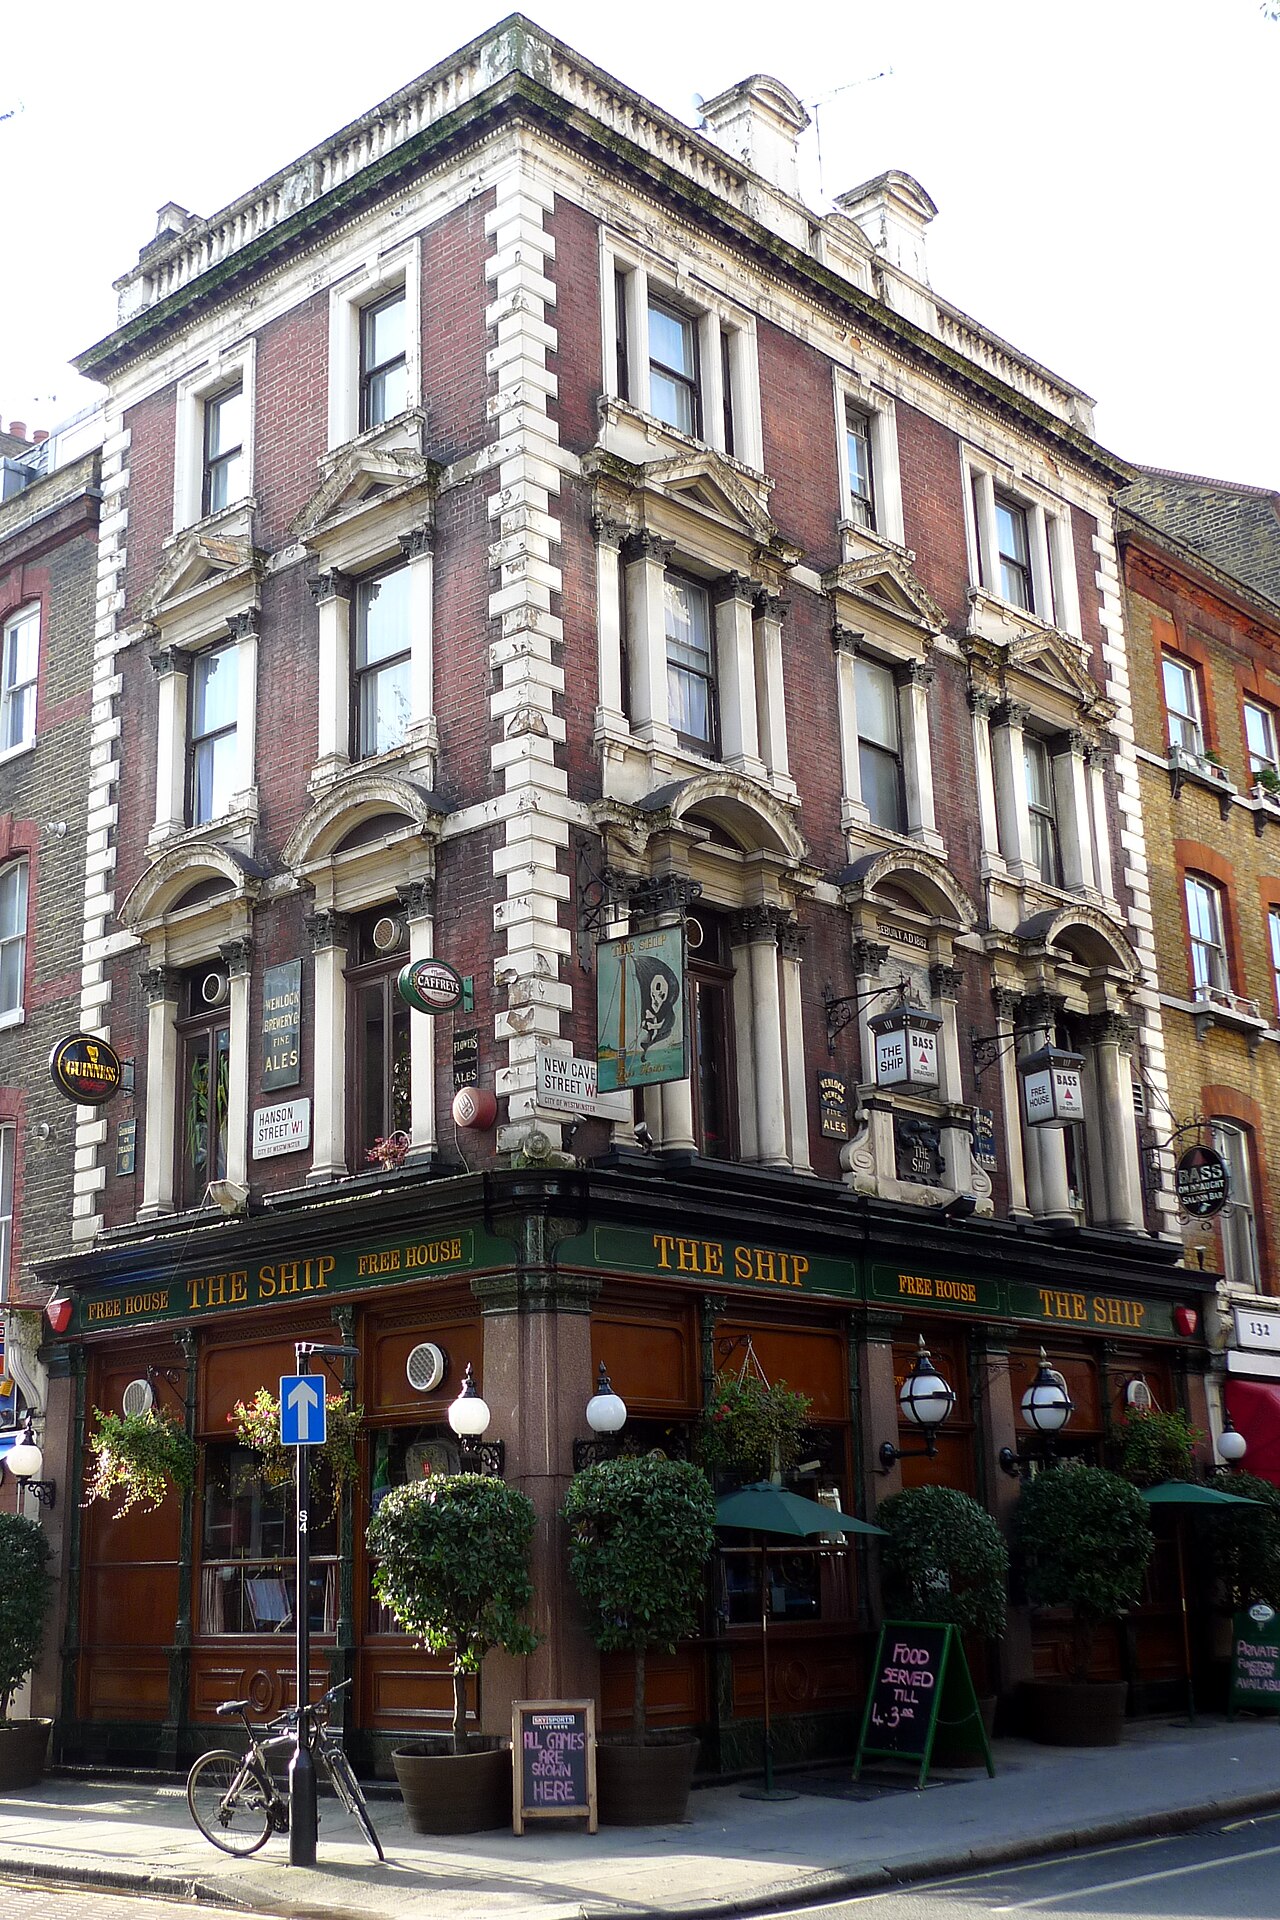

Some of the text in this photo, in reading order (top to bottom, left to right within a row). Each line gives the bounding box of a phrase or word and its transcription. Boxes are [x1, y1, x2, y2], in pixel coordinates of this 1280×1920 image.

[638, 934, 666, 951] SHIP
[264, 1013, 294, 1033] BREWERY
[273, 1034, 290, 1047] FINE
[912, 1035, 934, 1050] BASS
[881, 1044, 902, 1059] THE
[265, 1050, 298, 1073] ALES
[544, 1057, 567, 1075] NEW
[880, 1057, 904, 1072] SHIP
[65, 1061, 116, 1082] GUINNESS
[454, 1069, 477, 1084] ALES
[913, 1068, 935, 1078] DRAUGHT
[544, 1075, 582, 1094] STREET
[820, 1078, 846, 1094] WENLOCK
[1056, 1074, 1077, 1087] BASS
[822, 1090, 845, 1104] BREWERY
[1030, 1085, 1047, 1097] FREE
[544, 1097, 555, 1105] CITY
[563, 1100, 596, 1113] WESTMINSTER
[1029, 1094, 1050, 1108] HOUSE
[258, 1106, 293, 1127] HANSON
[258, 1119, 303, 1142] STREET W1
[823, 1119, 846, 1133] ALES
[257, 1148, 266, 1156] CITY
[273, 1140, 301, 1152] WESTMINSTER
[914, 1145, 929, 1160] THE
[912, 1158, 931, 1174] SHIP
[1178, 1164, 1223, 1185] BASS
[1178, 1180, 1224, 1194] ON DRAUGHT
[1182, 1191, 1223, 1205] SALOON BAR
[357, 1238, 461, 1276] FREE HOUSE
[653, 1234, 809, 1286] THE SHIP
[186, 1255, 336, 1310] THE SHIP
[898, 1274, 977, 1302] FREE HOUSE
[88, 1298, 121, 1321] FREE
[124, 1290, 169, 1315] HOUSE
[1039, 1289, 1145, 1328] THE SHIP
[1249, 1321, 1270, 1337] 132
[892, 1643, 930, 1665] FOOD
[1237, 1640, 1279, 1658] PRIVATE
[1238, 1658, 1275, 1671] FUNCTION
[1248, 1666, 1273, 1677] ROOM
[881, 1667, 934, 1688] SERVED
[894, 1688, 919, 1704] TILL
[523, 1731, 585, 1750] ALL GAMES
[538, 1749, 564, 1765] ARE
[531, 1762, 572, 1777] SHOWN
[533, 1780, 576, 1801] HERE
